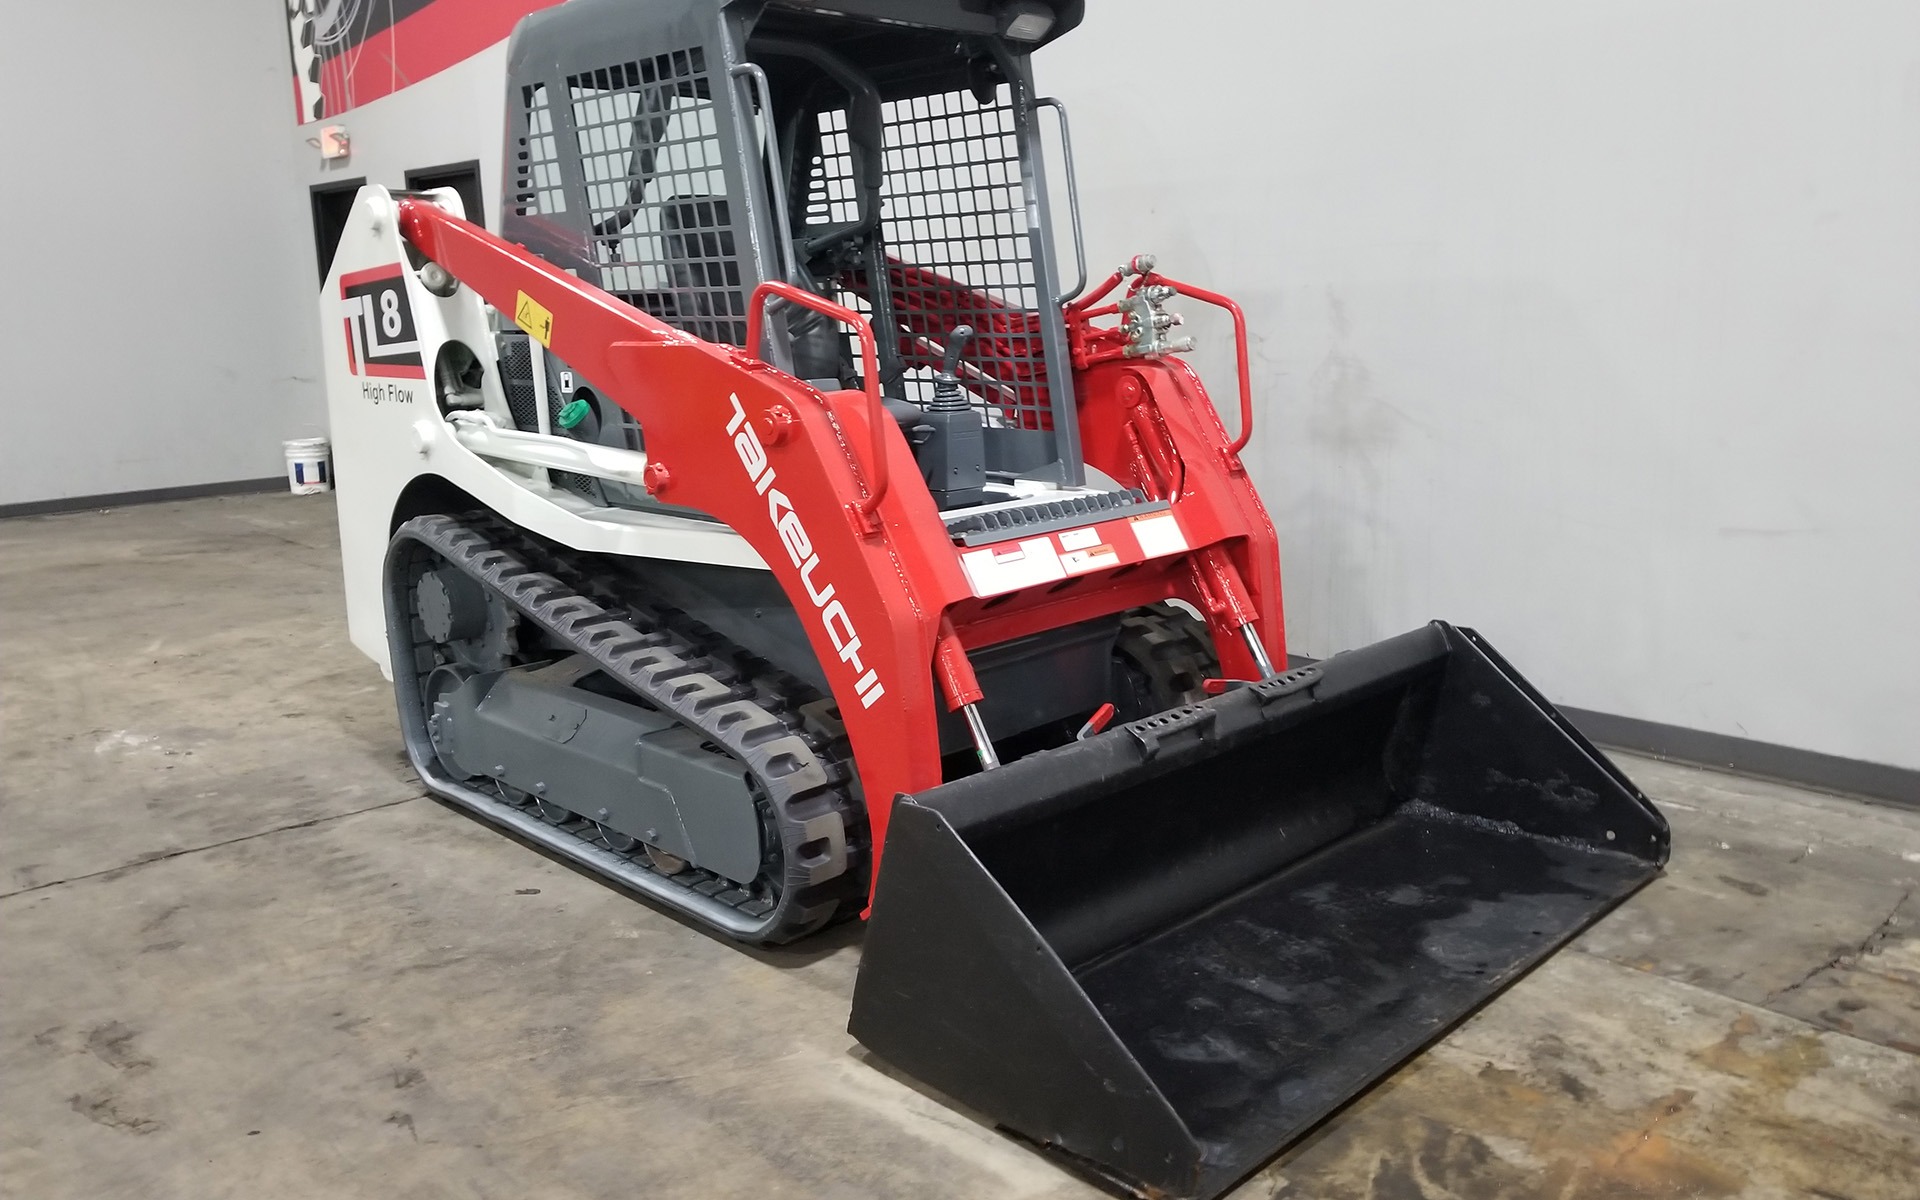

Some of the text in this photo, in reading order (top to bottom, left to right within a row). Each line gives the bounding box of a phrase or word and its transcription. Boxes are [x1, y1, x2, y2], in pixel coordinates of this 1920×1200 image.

[340, 289, 420, 377] TL8
[362, 382, 413, 404] High Flow
